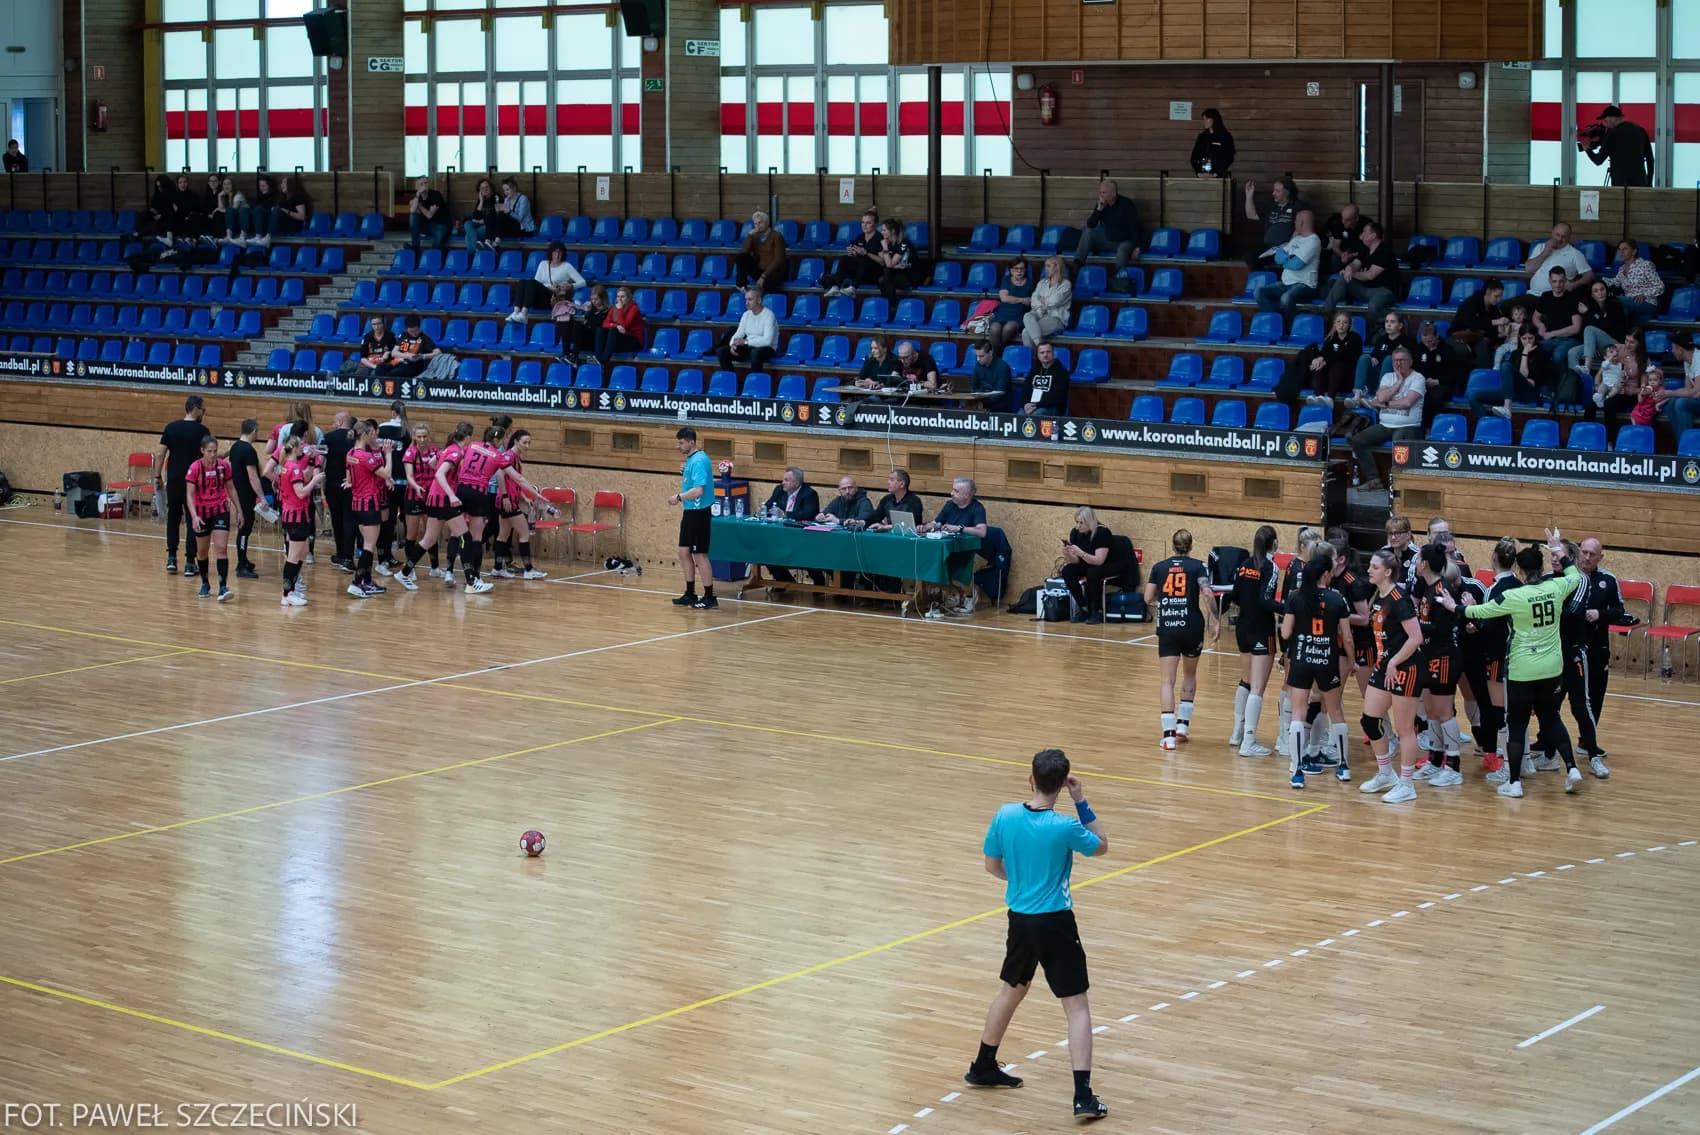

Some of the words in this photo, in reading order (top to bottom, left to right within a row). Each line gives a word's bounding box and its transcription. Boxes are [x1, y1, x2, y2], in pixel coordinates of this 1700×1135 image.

[88, 363, 197, 385] www.koronahandball.pl
[429, 385, 562, 407] www.koronahandball.pl
[630, 395, 777, 420] www.koronahandball.pl
[854, 410, 1017, 437] www.koronahandball.pl
[1101, 426, 1280, 456] www.koronahandball.pl
[468, 451, 489, 474] 21
[1467, 451, 1677, 482] www.koronahandball.pl
[1162, 573, 1186, 597] 49
[1161, 608, 1188, 618] lubin.pl
[1532, 600, 1555, 627] 99
[1305, 645, 1331, 658] lubin.pl
